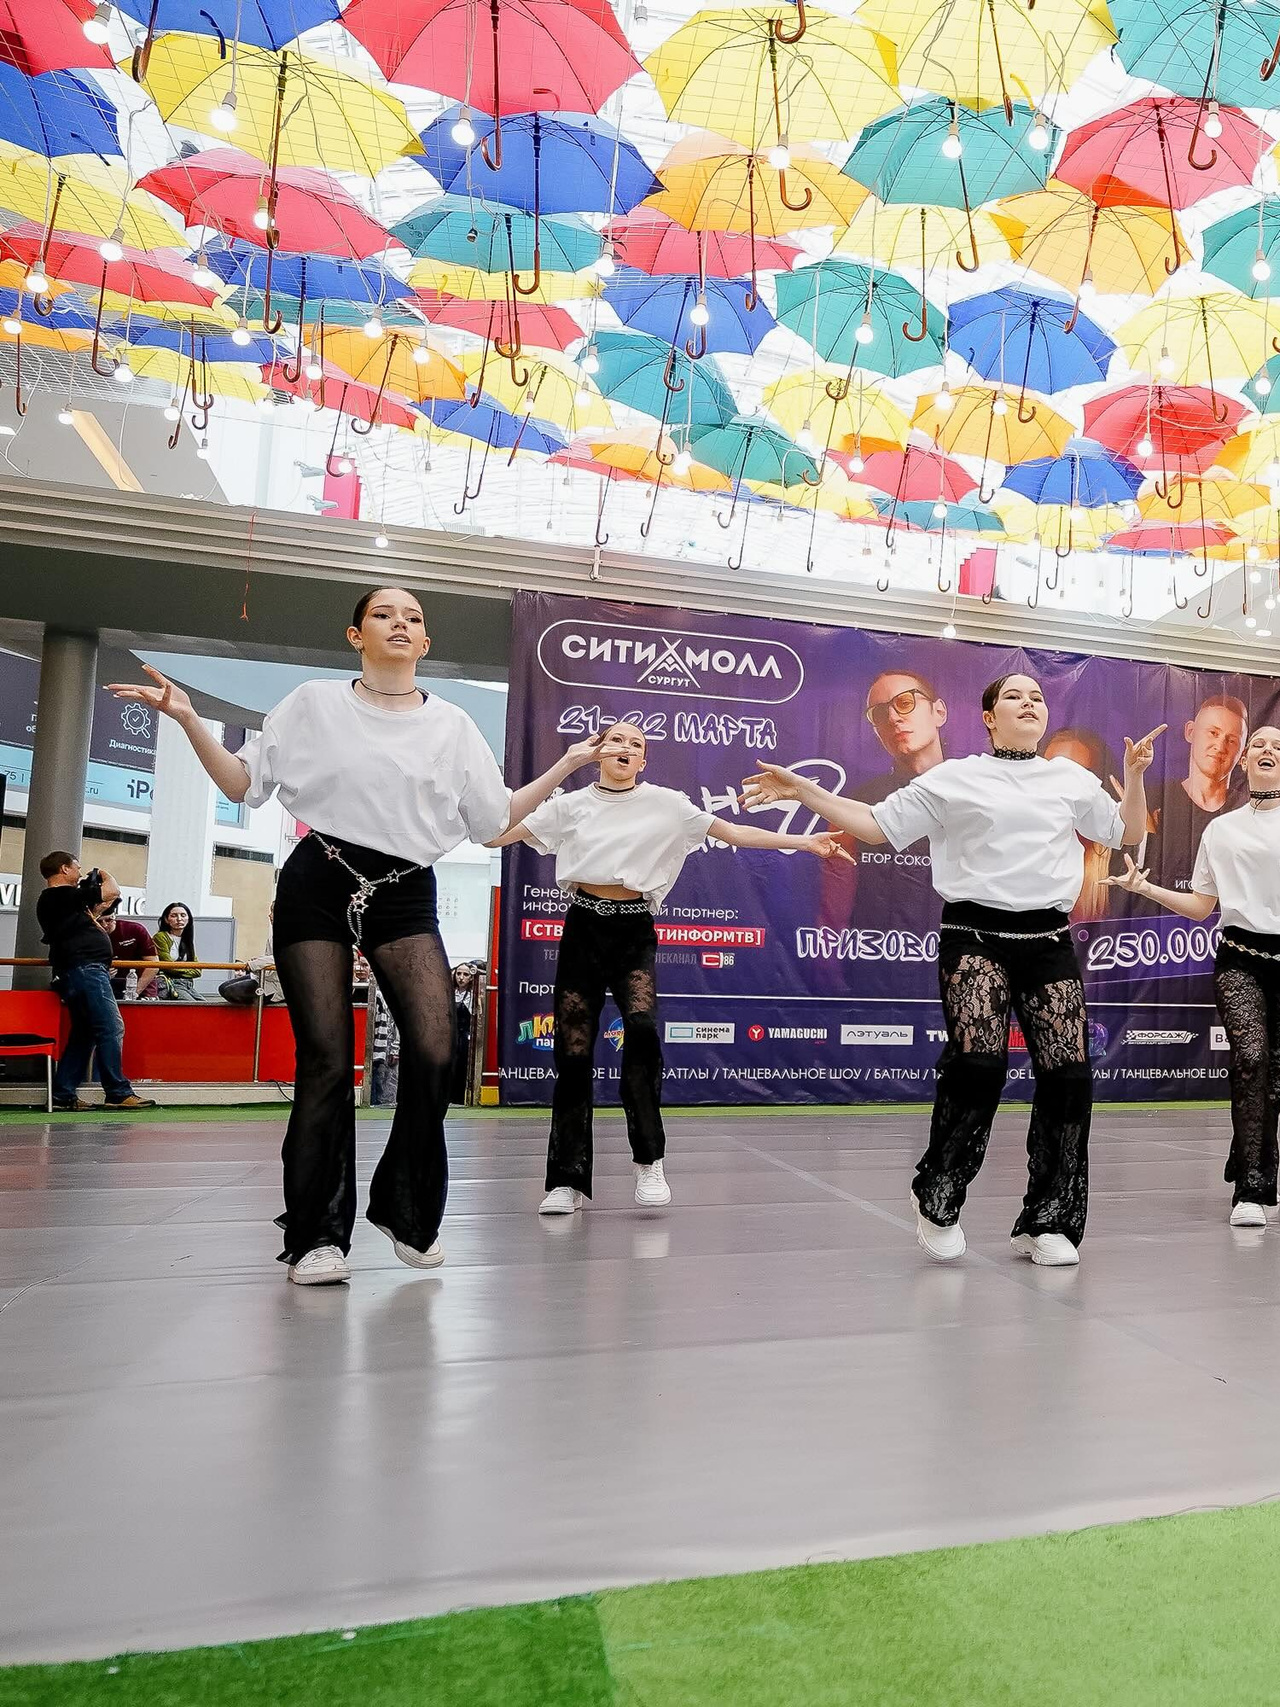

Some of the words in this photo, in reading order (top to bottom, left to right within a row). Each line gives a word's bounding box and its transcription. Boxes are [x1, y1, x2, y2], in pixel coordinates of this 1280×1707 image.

[562, 635, 656, 665] СИТИ
[686, 646, 783, 680] МОЛЛ
[648, 675, 692, 688] СУРГУТ
[674, 711, 778, 750] МАРТА
[861, 852, 892, 865] ЕГОР
[672, 907, 739, 921] партнер:
[655, 929, 761, 946] ТИНФОРМТВ]
[696, 1026, 730, 1034] синема
[768, 1027, 828, 1040] YAMAGUCHI
[696, 1033, 719, 1041] парк
[723, 1068, 826, 1081] ТАНЦЕВАЛЬНОЕ
[829, 1068, 862, 1080] ШОУ
[874, 1068, 920, 1080] БАТТЛЫ
[1121, 1068, 1206, 1080] ТАНЦЕВАЛЬНОЕ
